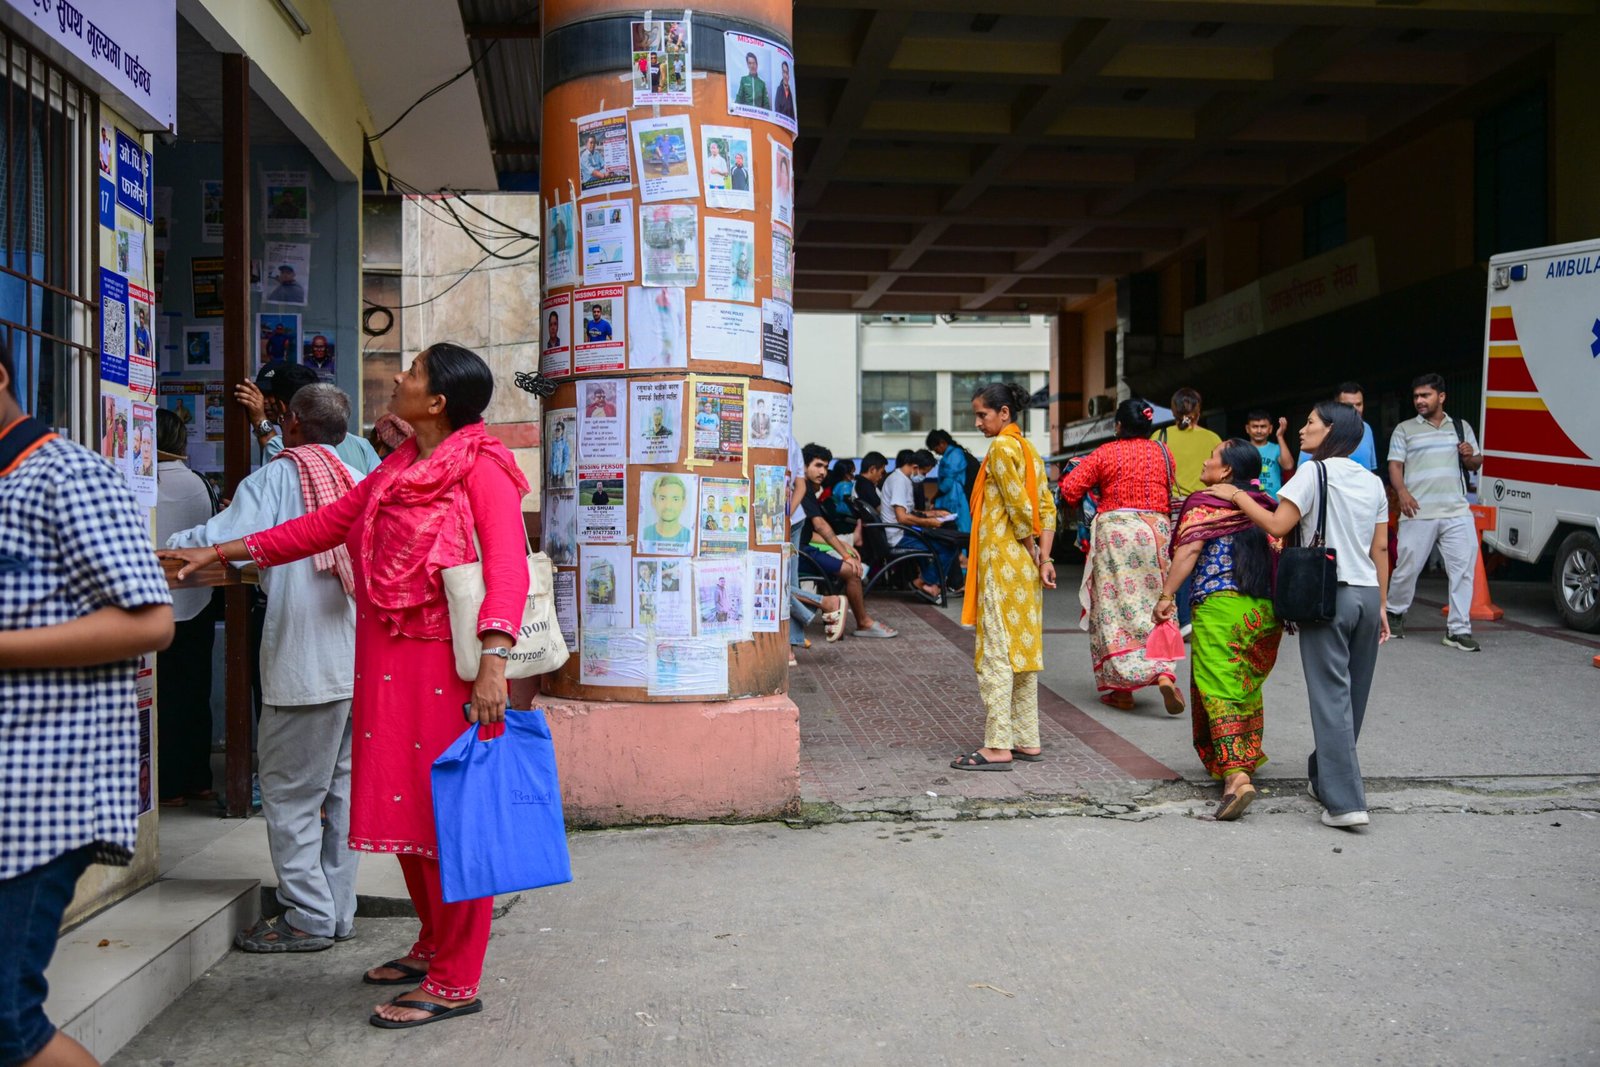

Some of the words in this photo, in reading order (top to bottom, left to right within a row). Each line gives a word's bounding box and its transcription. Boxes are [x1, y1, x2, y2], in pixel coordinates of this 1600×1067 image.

[87, 20, 121, 70] मूल्यमा
[737, 35, 765, 48] MISSING
[101, 189, 110, 214] 17
[575, 290, 596, 299] MISSING
[597, 288, 623, 297] PERSON
[1506, 489, 1532, 500] FOTON
